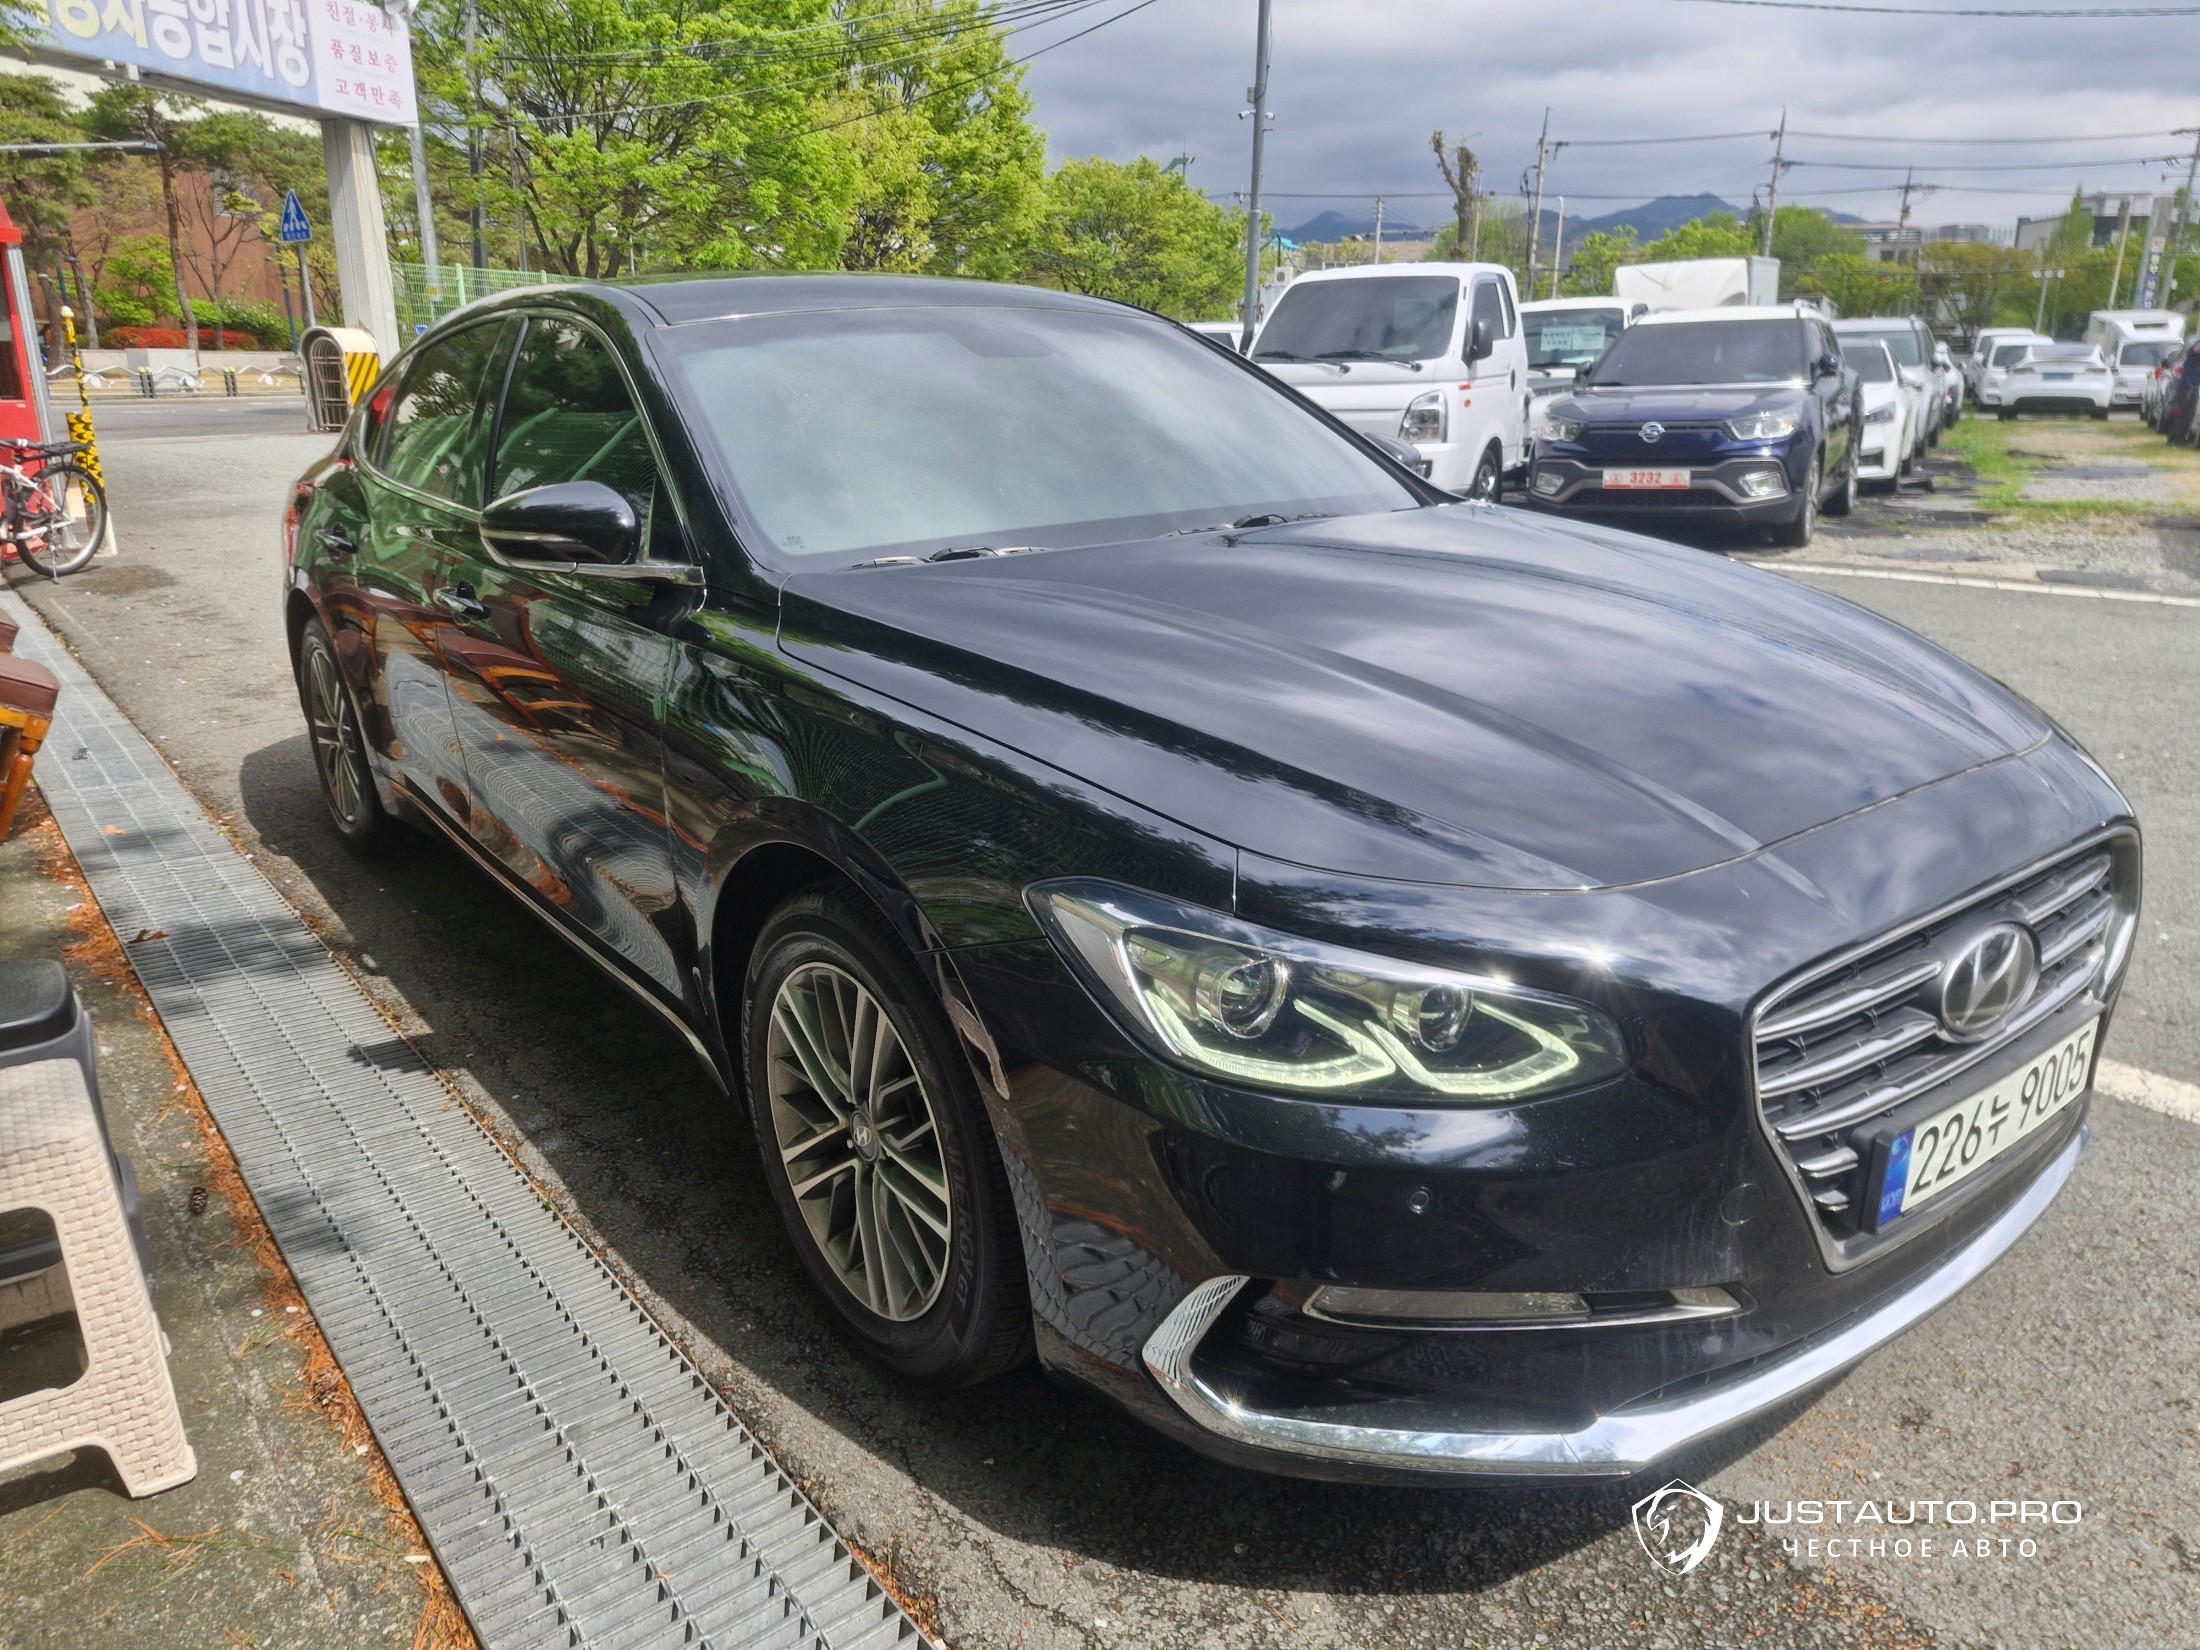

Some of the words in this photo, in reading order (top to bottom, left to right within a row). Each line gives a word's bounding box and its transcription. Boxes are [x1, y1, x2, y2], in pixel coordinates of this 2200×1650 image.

[330, 39, 399, 74] 품질보증
[335, 78, 402, 110] 고객만족
[1630, 471, 1662, 484] 3232
[1912, 1095, 2009, 1195] 226누
[2019, 1030, 2090, 1128] 9005
